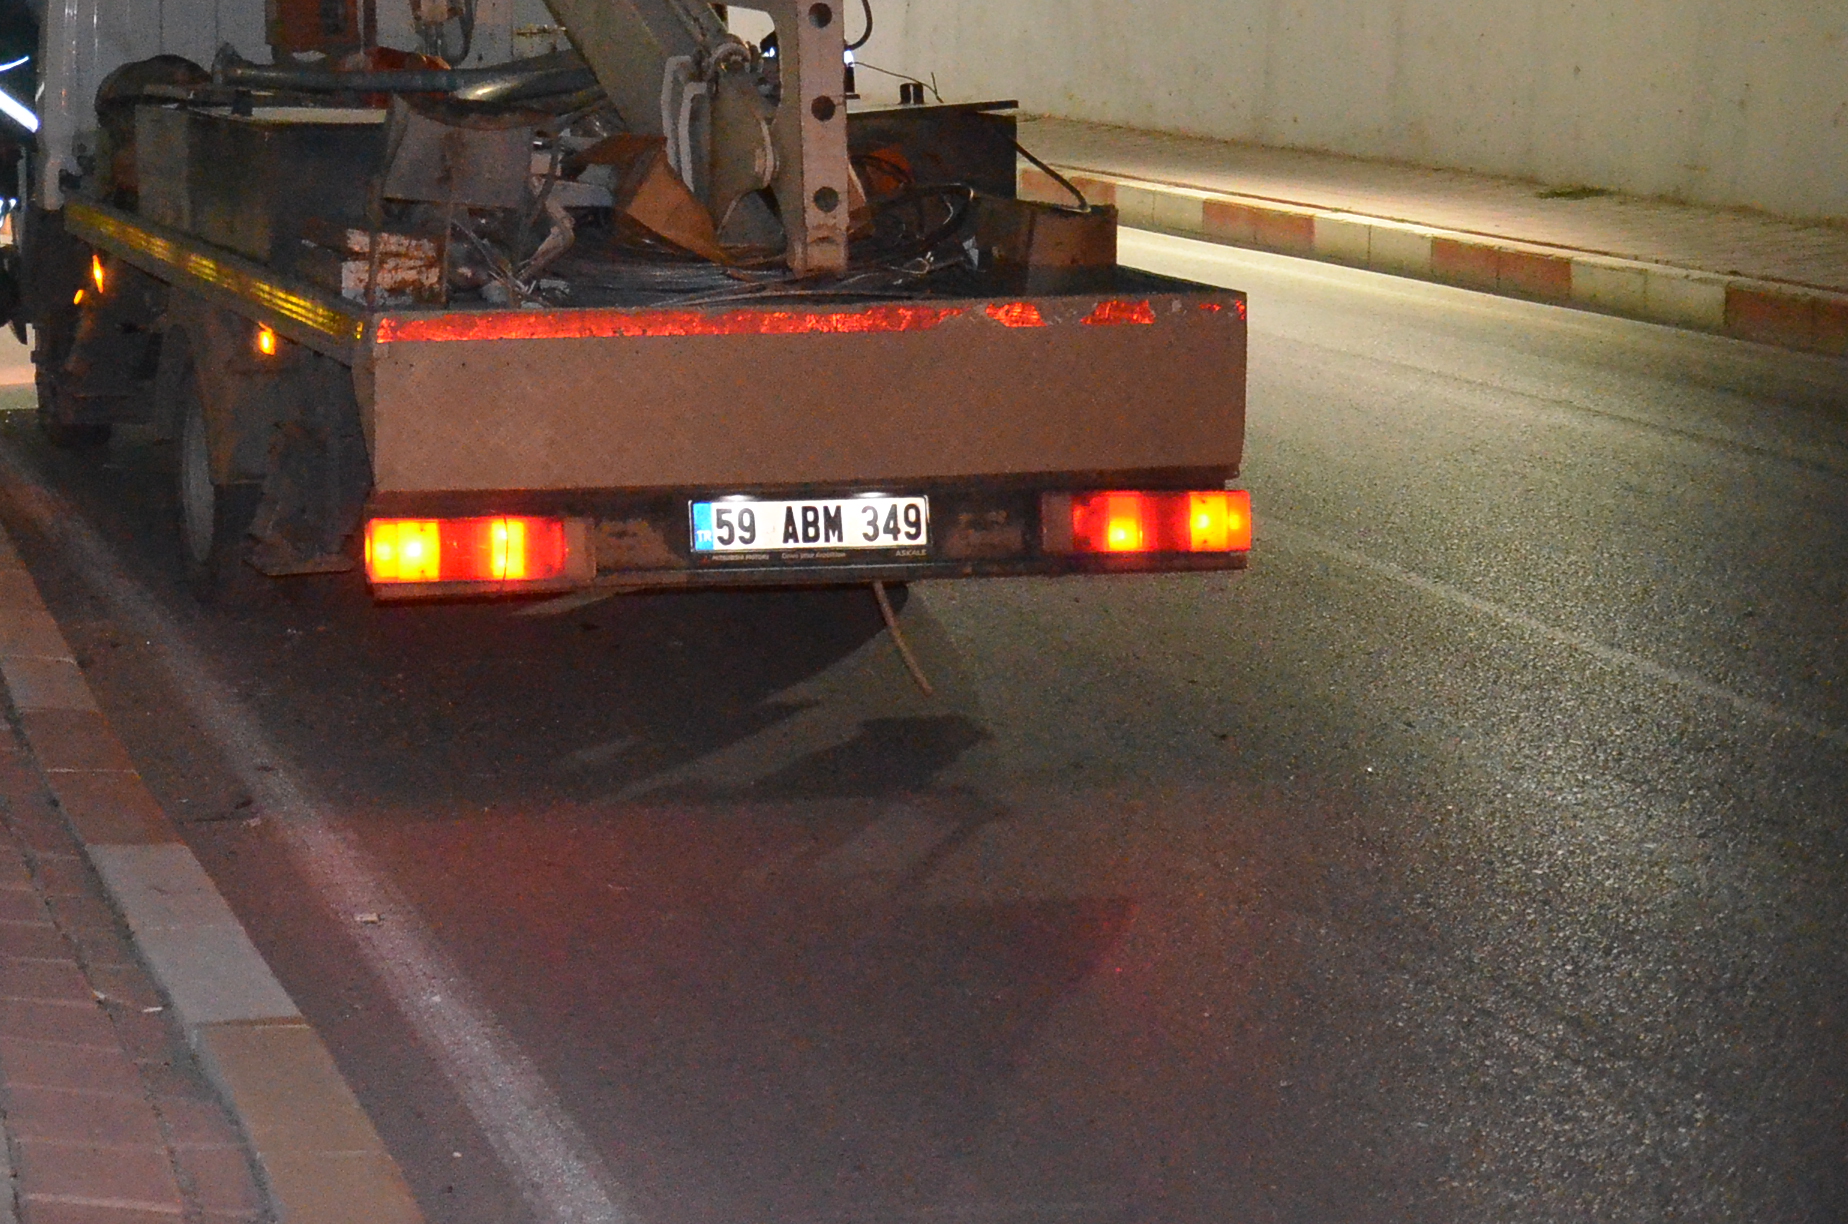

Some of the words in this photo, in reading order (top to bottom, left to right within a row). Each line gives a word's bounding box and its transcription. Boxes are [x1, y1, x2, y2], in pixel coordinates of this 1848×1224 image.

[696, 530, 712, 543] TR
[716, 508, 756, 546] 59
[782, 505, 844, 544] ABM
[860, 503, 922, 542] 349
